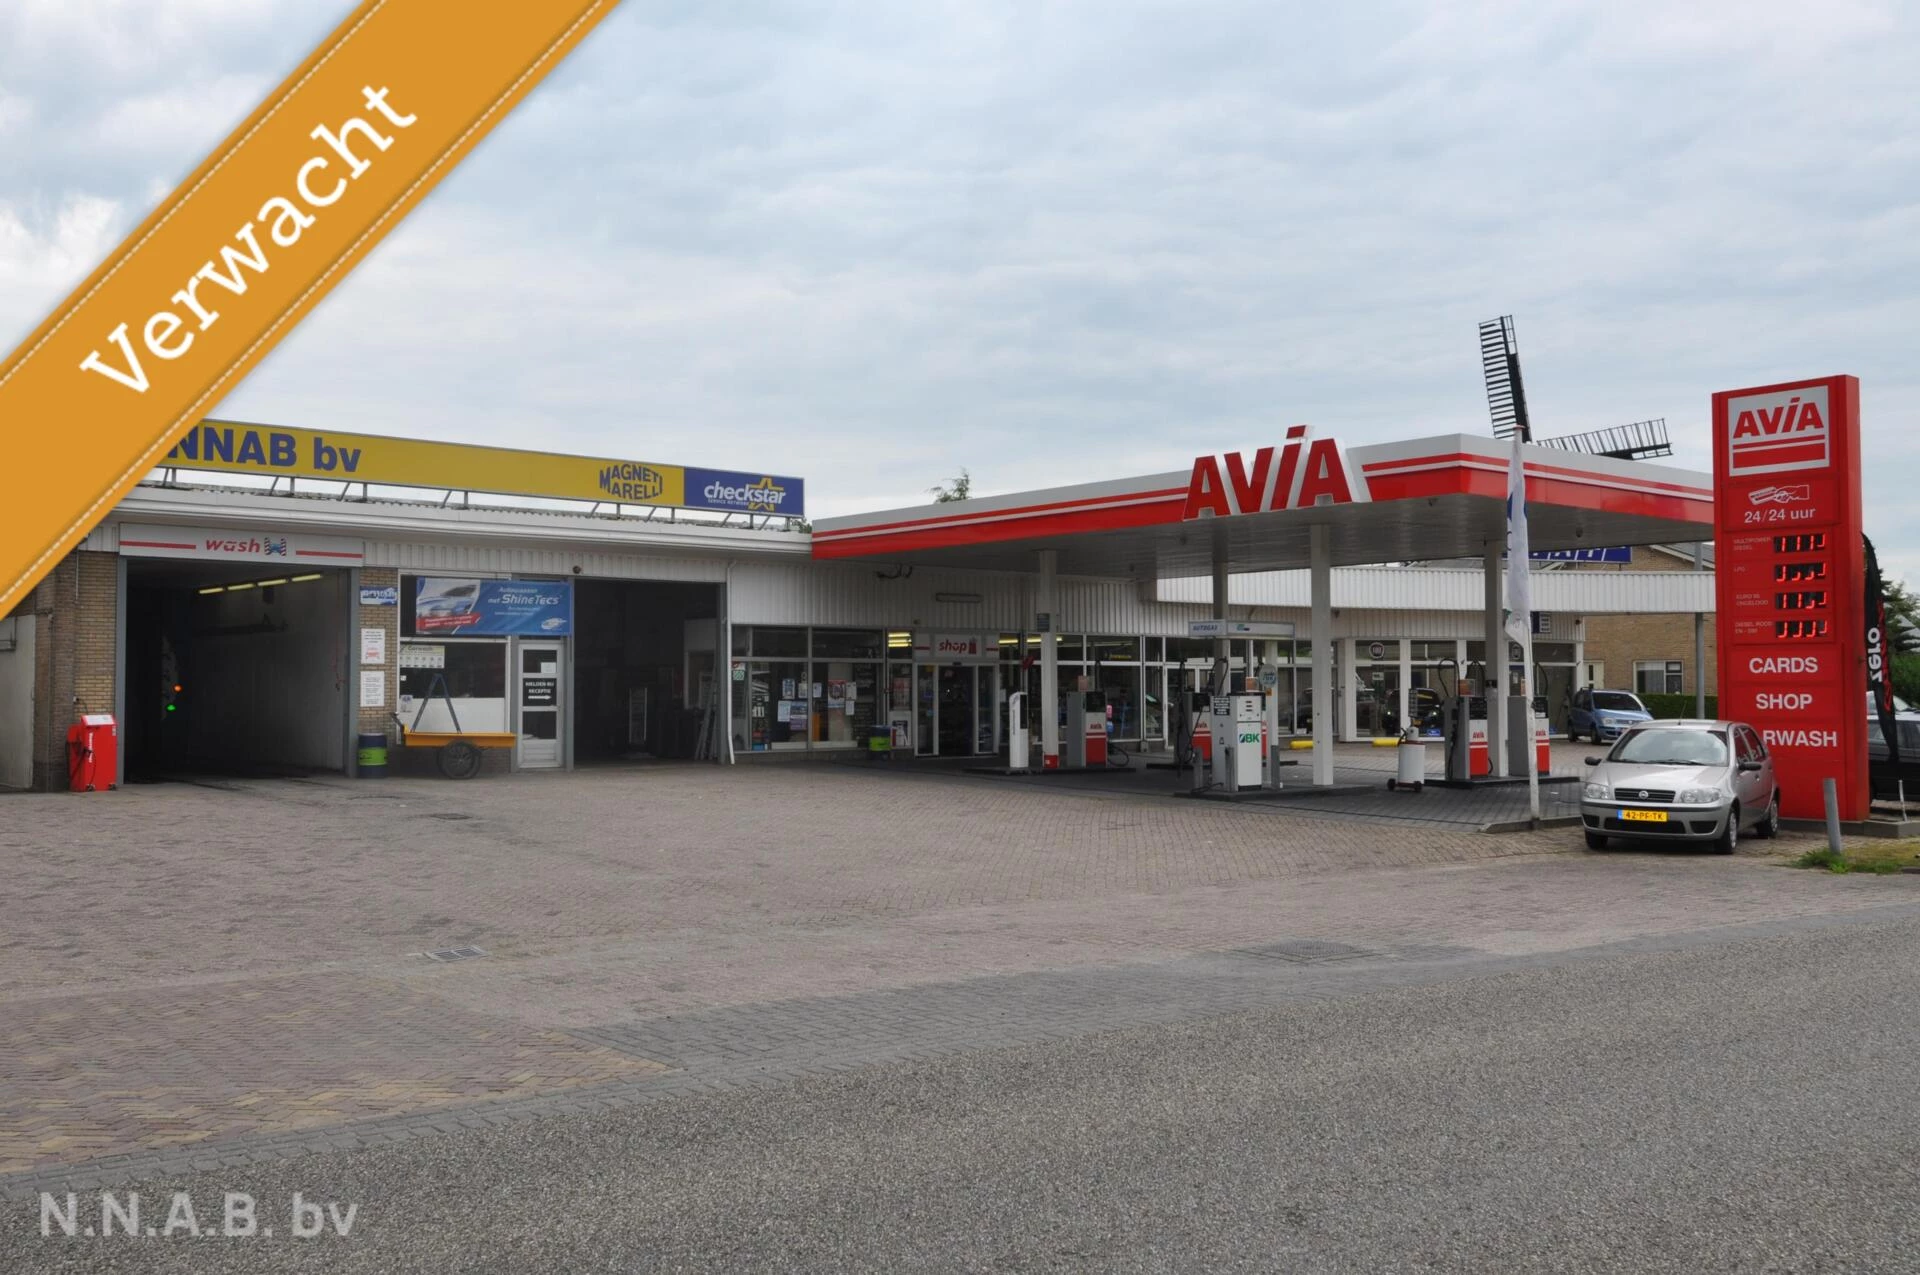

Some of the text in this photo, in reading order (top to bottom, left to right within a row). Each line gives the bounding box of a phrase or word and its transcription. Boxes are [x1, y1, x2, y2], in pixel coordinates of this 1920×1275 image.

[313, 437, 362, 473] bv
[599, 463, 663, 493] MAGNETI
[704, 481, 787, 504] checkstar
[1744, 508, 1816, 523] 24/24 uur
[205, 537, 261, 553] wash
[939, 638, 967, 654] shop
[1749, 657, 1818, 673] CARDS
[1756, 693, 1813, 710] SHOP
[1762, 730, 1838, 747] RWASH
